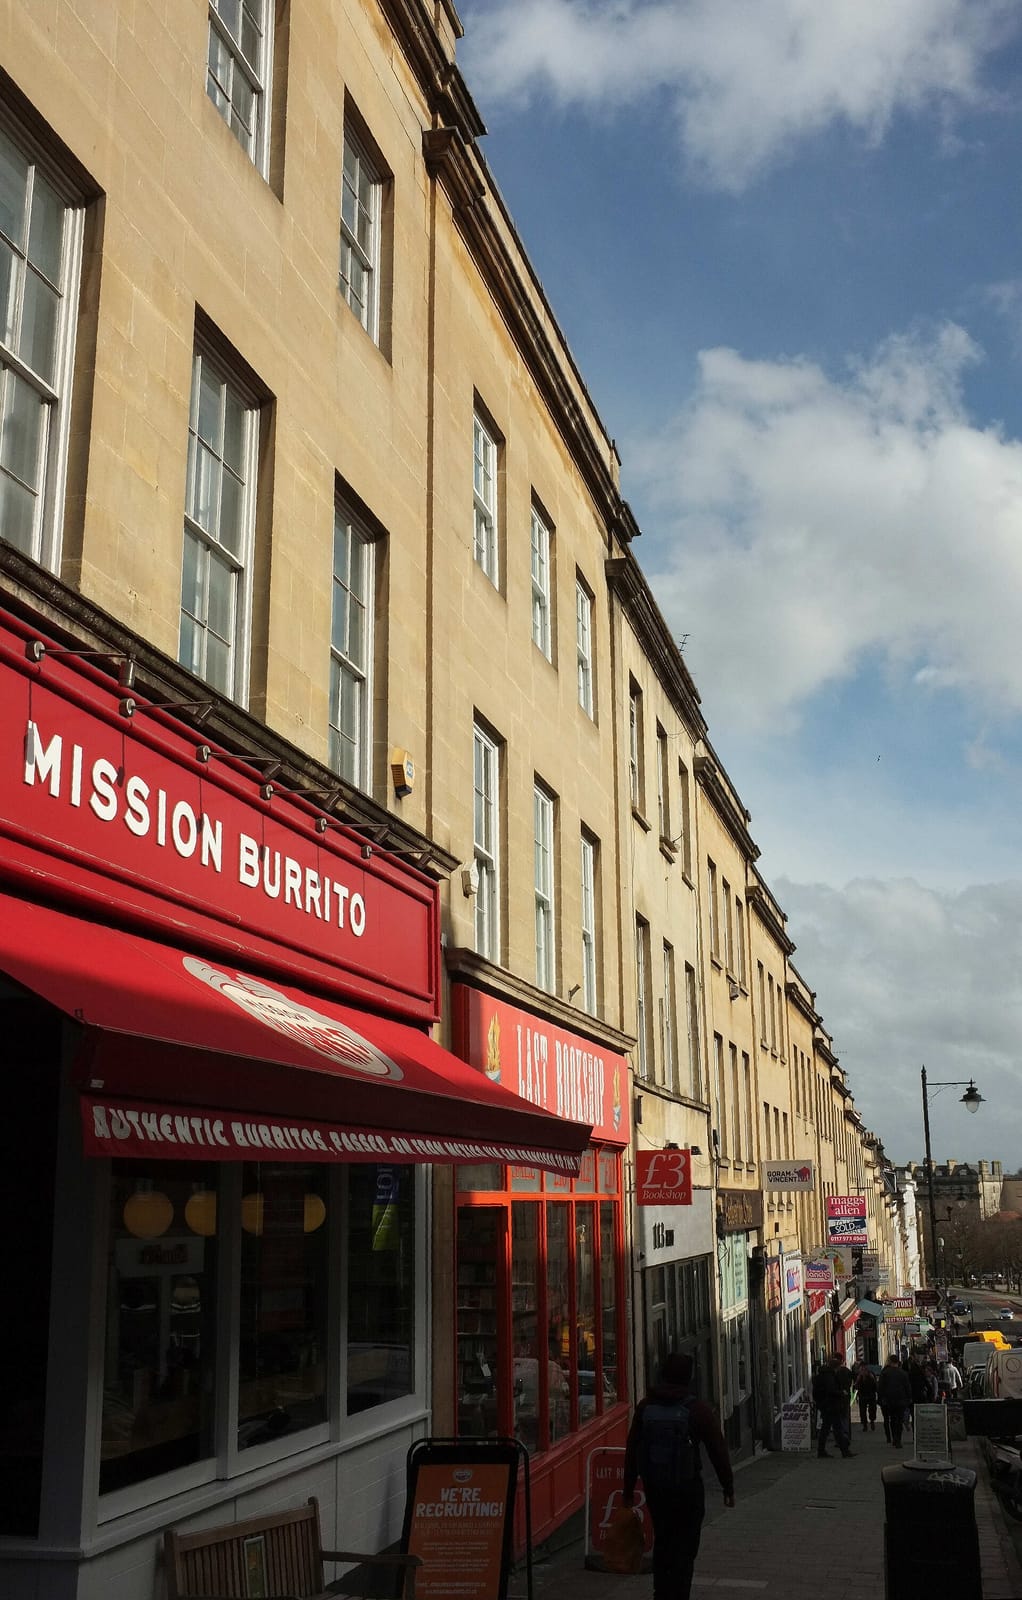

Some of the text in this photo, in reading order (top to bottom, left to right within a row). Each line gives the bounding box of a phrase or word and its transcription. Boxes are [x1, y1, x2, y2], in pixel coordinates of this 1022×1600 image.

[23, 720, 367, 937] MISSION BURRITO
[516, 1024, 605, 1127] LAST BOOKSHOP
[92, 1105, 230, 1147] AUTHENTIC
[410, 1138, 449, 1156] FROM
[444, 1141, 489, 1159] MEXICO
[641, 1153, 686, 1189] £3
[642, 1189, 687, 1201] Bookshop
[830, 1196, 864, 1207] maggs
[835, 1204, 860, 1215] allen
[834, 1222, 856, 1234] SOLD
[440, 1487, 482, 1502] WE'RE
[415, 1502, 504, 1518] RECRUITING!
